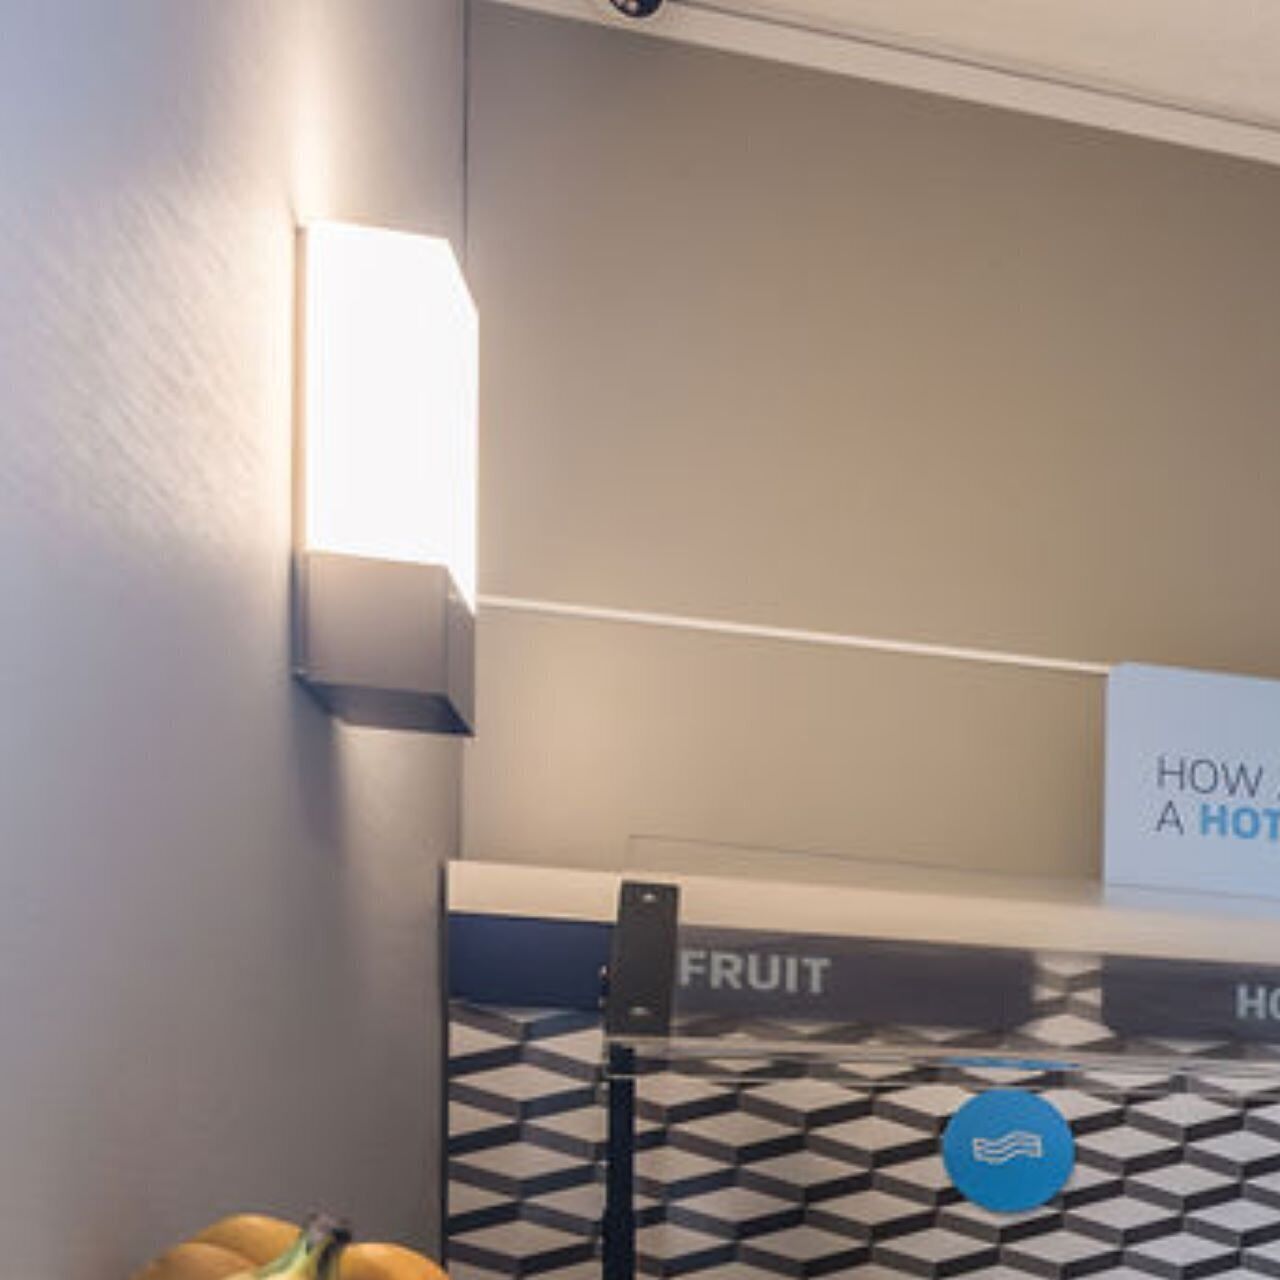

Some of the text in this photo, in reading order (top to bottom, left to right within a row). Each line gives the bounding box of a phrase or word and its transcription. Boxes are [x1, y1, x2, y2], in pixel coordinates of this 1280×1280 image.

[1156, 755, 1264, 799] HOW
[1156, 800, 1185, 836] A
[677, 948, 832, 995] FRUIT
